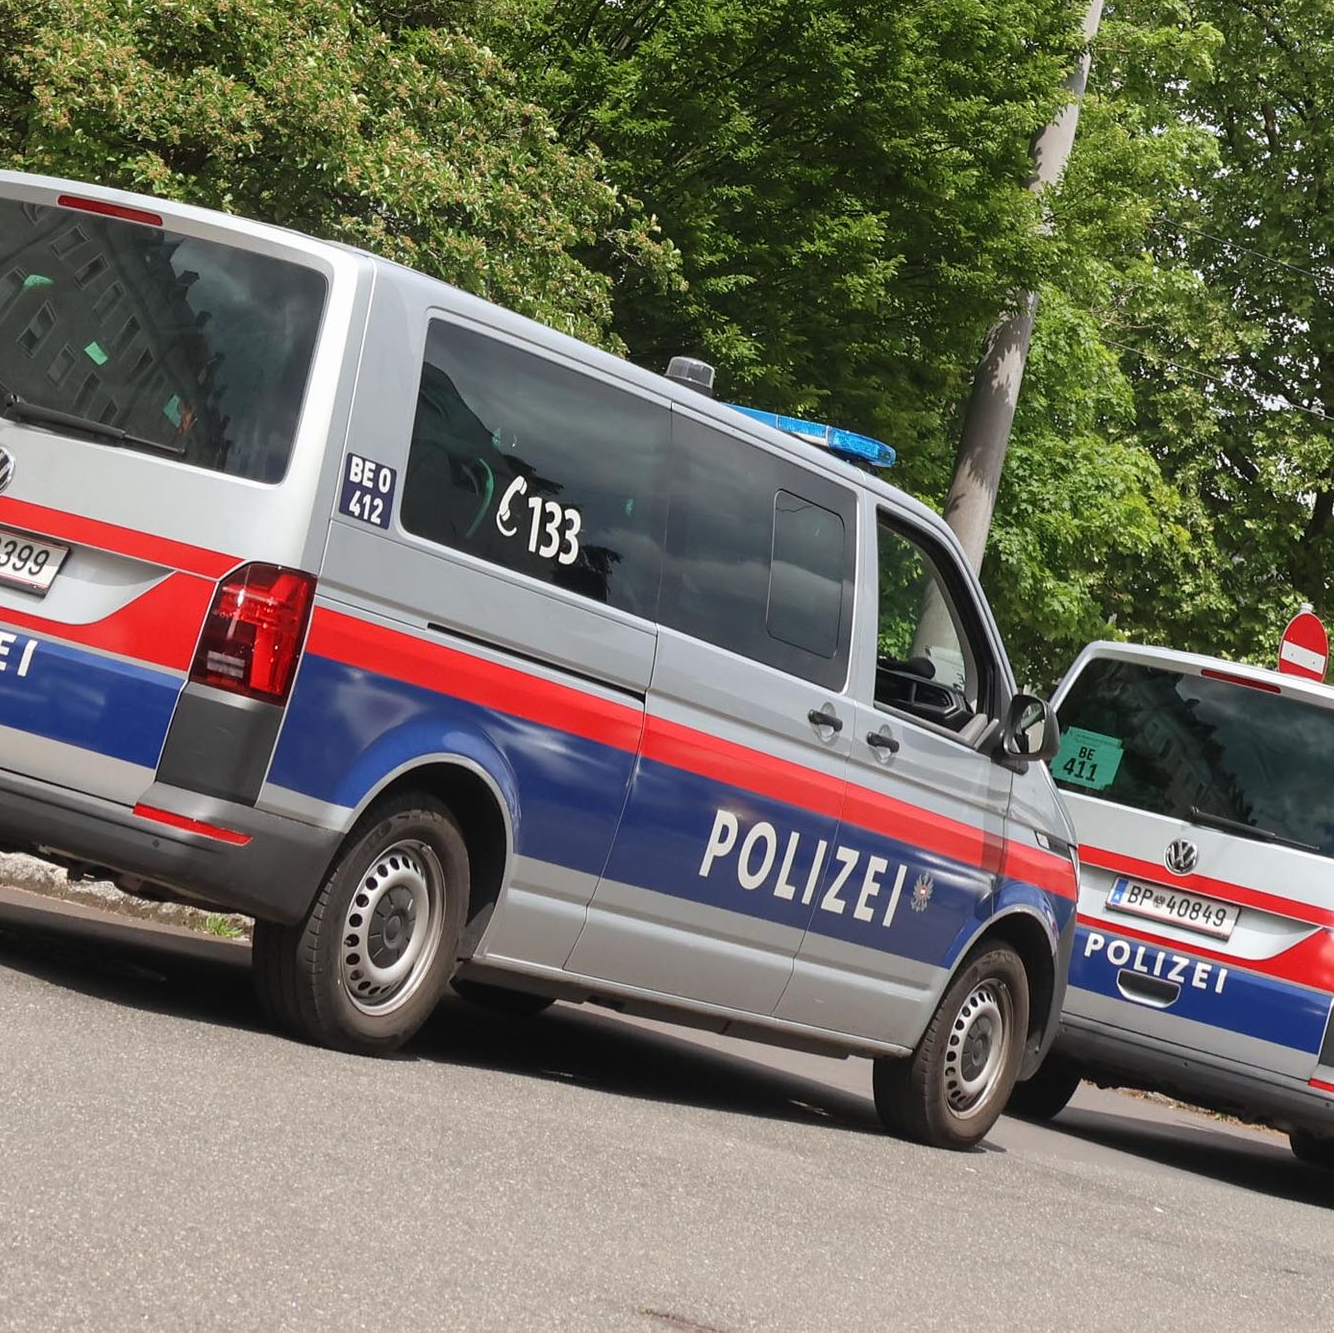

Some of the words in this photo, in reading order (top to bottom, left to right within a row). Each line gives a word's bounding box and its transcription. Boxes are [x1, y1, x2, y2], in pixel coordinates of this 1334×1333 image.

[349, 456, 376, 489] BE
[349, 490, 384, 525] 412
[528, 497, 581, 565] 133
[1063, 757, 1098, 782] 411
[1078, 746, 1096, 761] BE
[698, 808, 908, 928] POLIZEI
[1127, 885, 1154, 906] BP
[1166, 895, 1227, 927] 40849
[1083, 932, 1228, 994] POLIZEI
